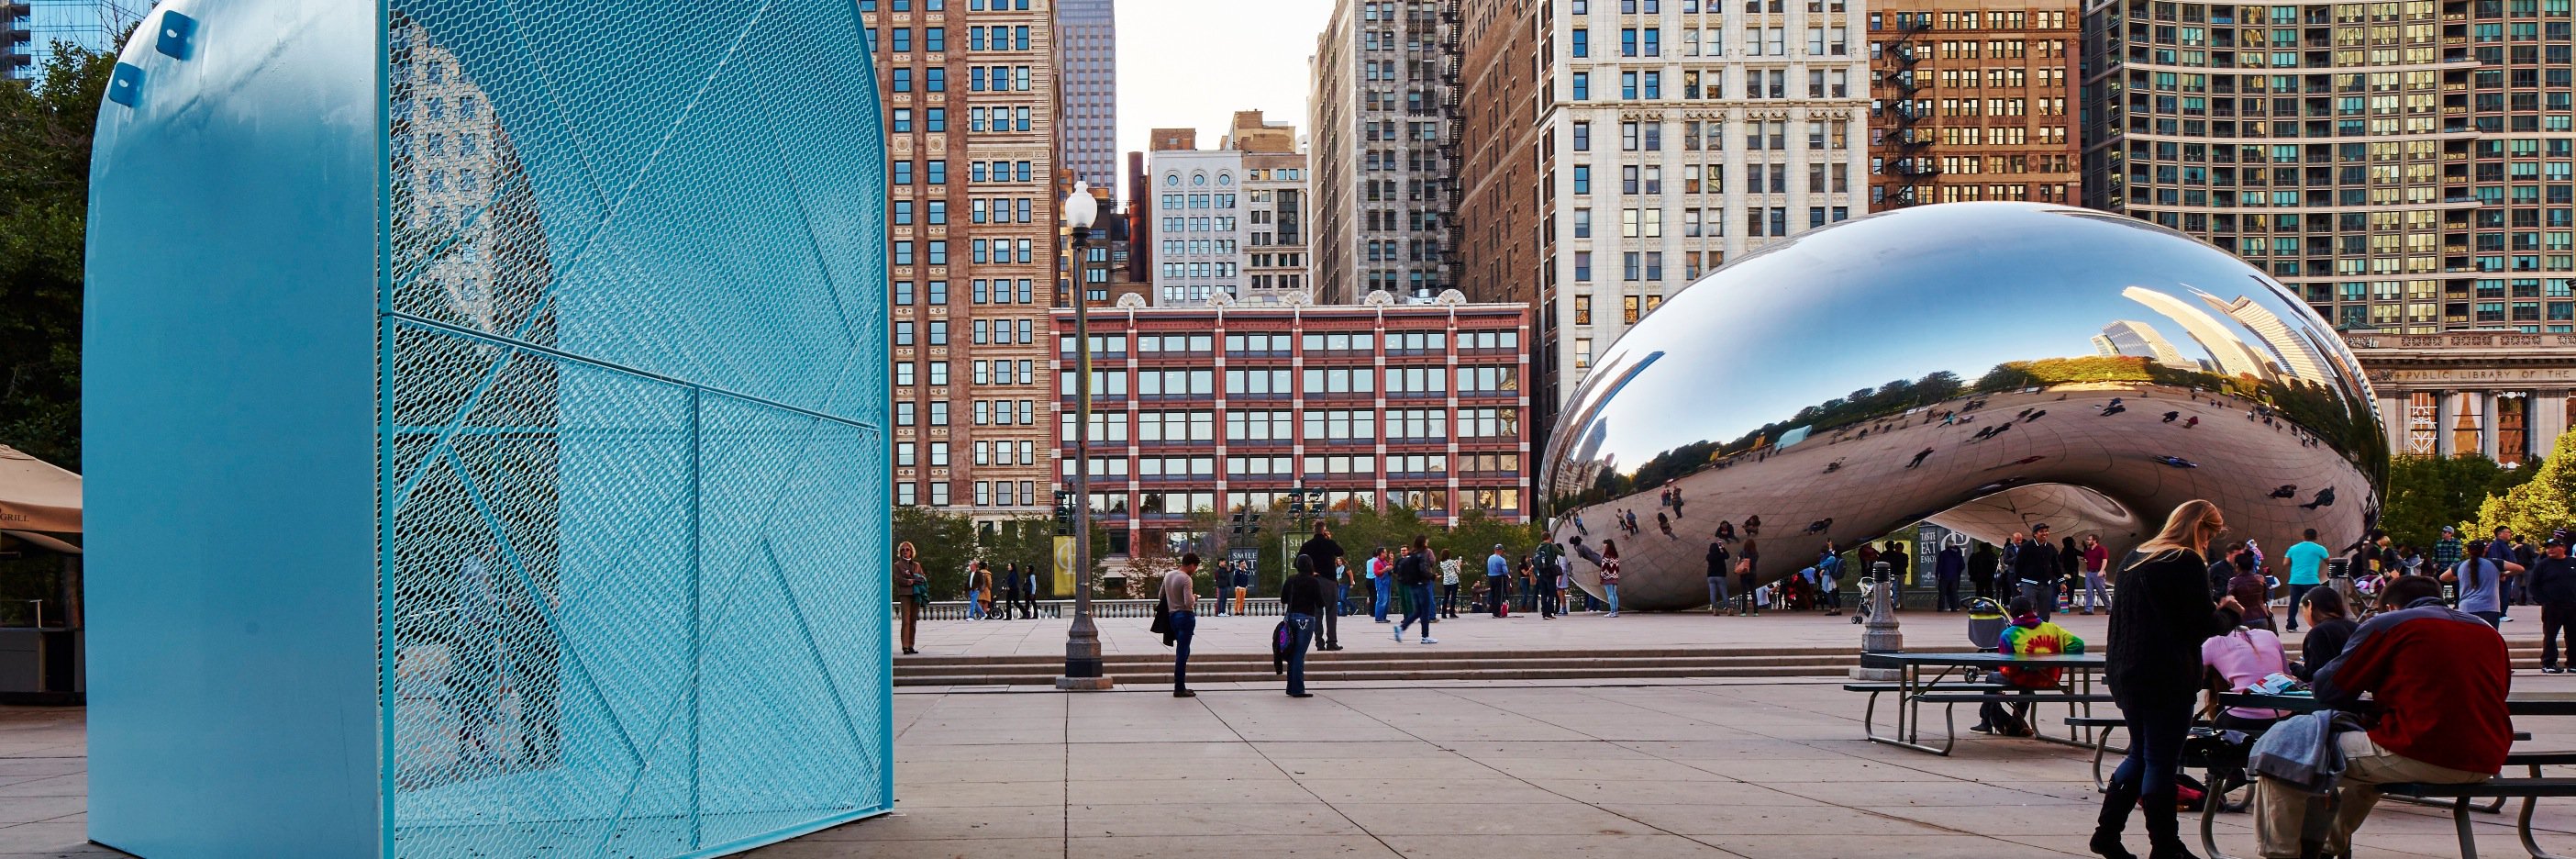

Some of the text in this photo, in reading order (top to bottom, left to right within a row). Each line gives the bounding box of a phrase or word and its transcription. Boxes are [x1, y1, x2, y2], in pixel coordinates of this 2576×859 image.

[2459, 371, 2511, 379] LIBRARY
[2522, 370, 2536, 379] OF
[2548, 370, 2570, 379] THE
[0, 513, 29, 522] GRILL
[1920, 531, 1936, 541] TASTE
[1921, 541, 1936, 554] EAT
